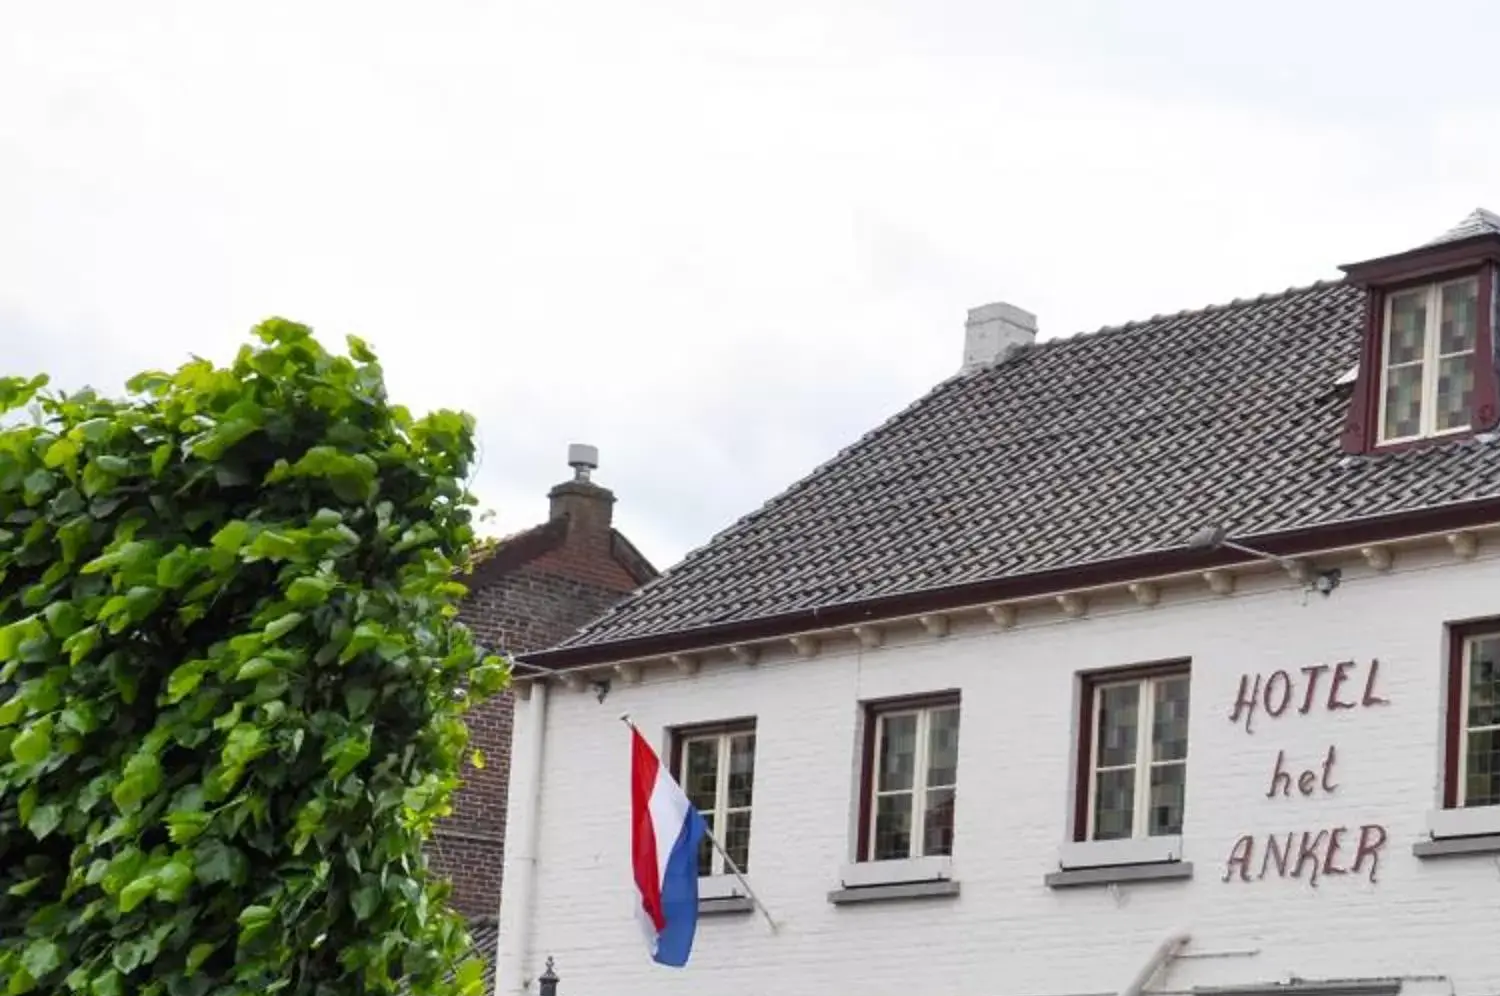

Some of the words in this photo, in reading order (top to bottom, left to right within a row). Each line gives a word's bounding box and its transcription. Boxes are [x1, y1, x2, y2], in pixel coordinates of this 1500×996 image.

[1228, 658, 1391, 735] HOTEL
[1265, 745, 1338, 798] het
[1222, 824, 1387, 888] ANKER
